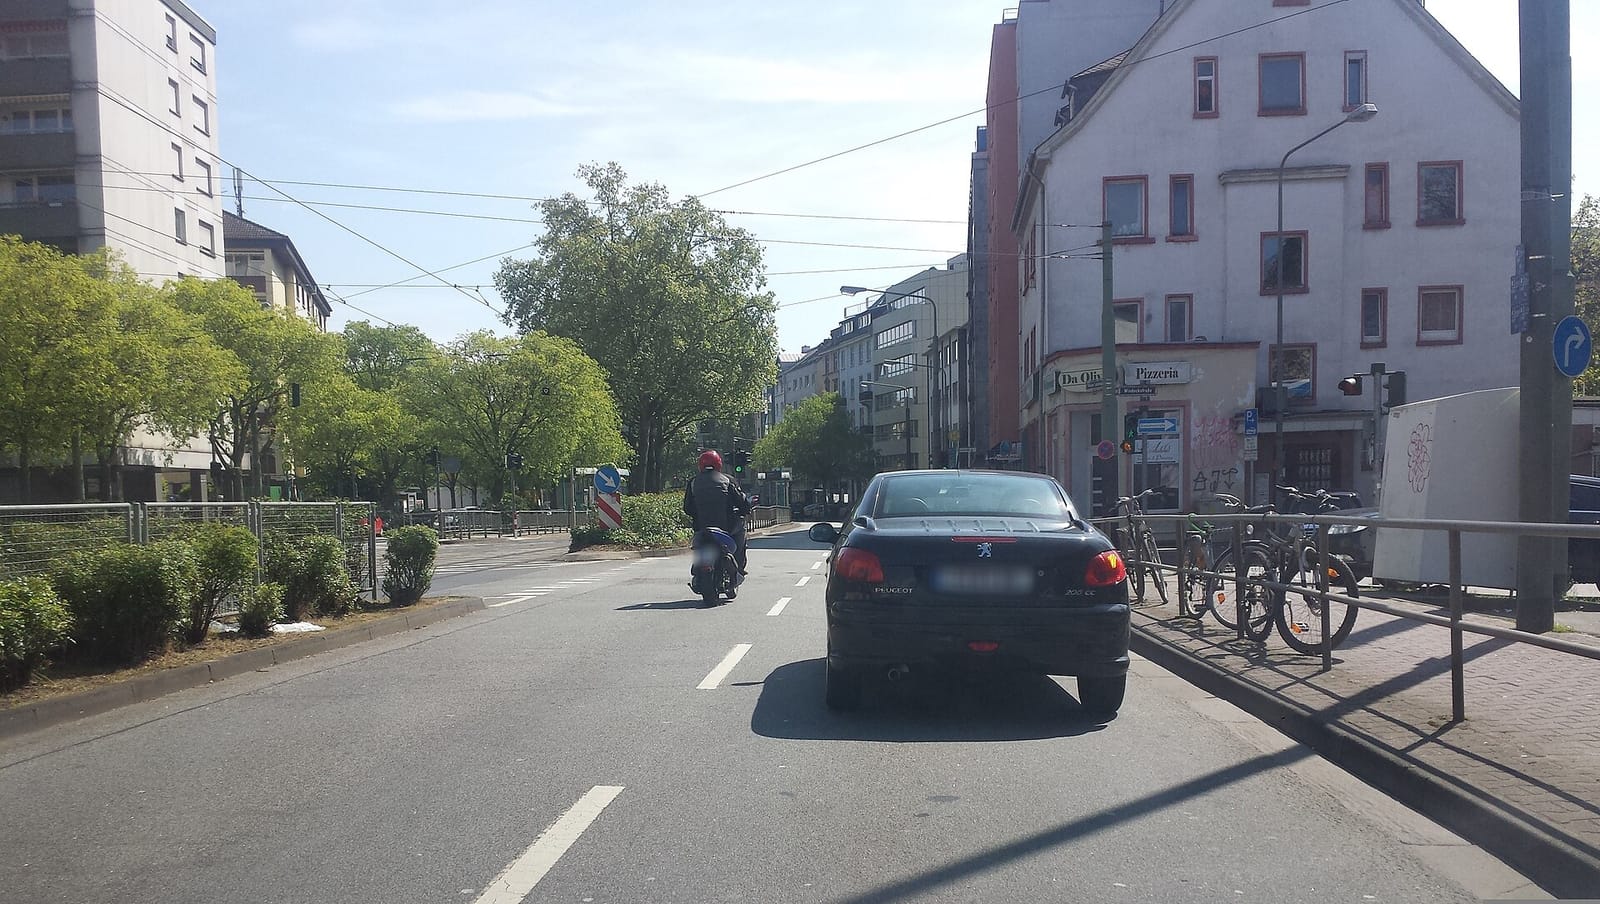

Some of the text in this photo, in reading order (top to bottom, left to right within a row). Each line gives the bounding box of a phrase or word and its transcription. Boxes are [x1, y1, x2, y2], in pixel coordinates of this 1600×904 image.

[1062, 374, 1078, 385] Da
[1080, 371, 1102, 383] Oliv
[1136, 367, 1179, 379] Pizzeria
